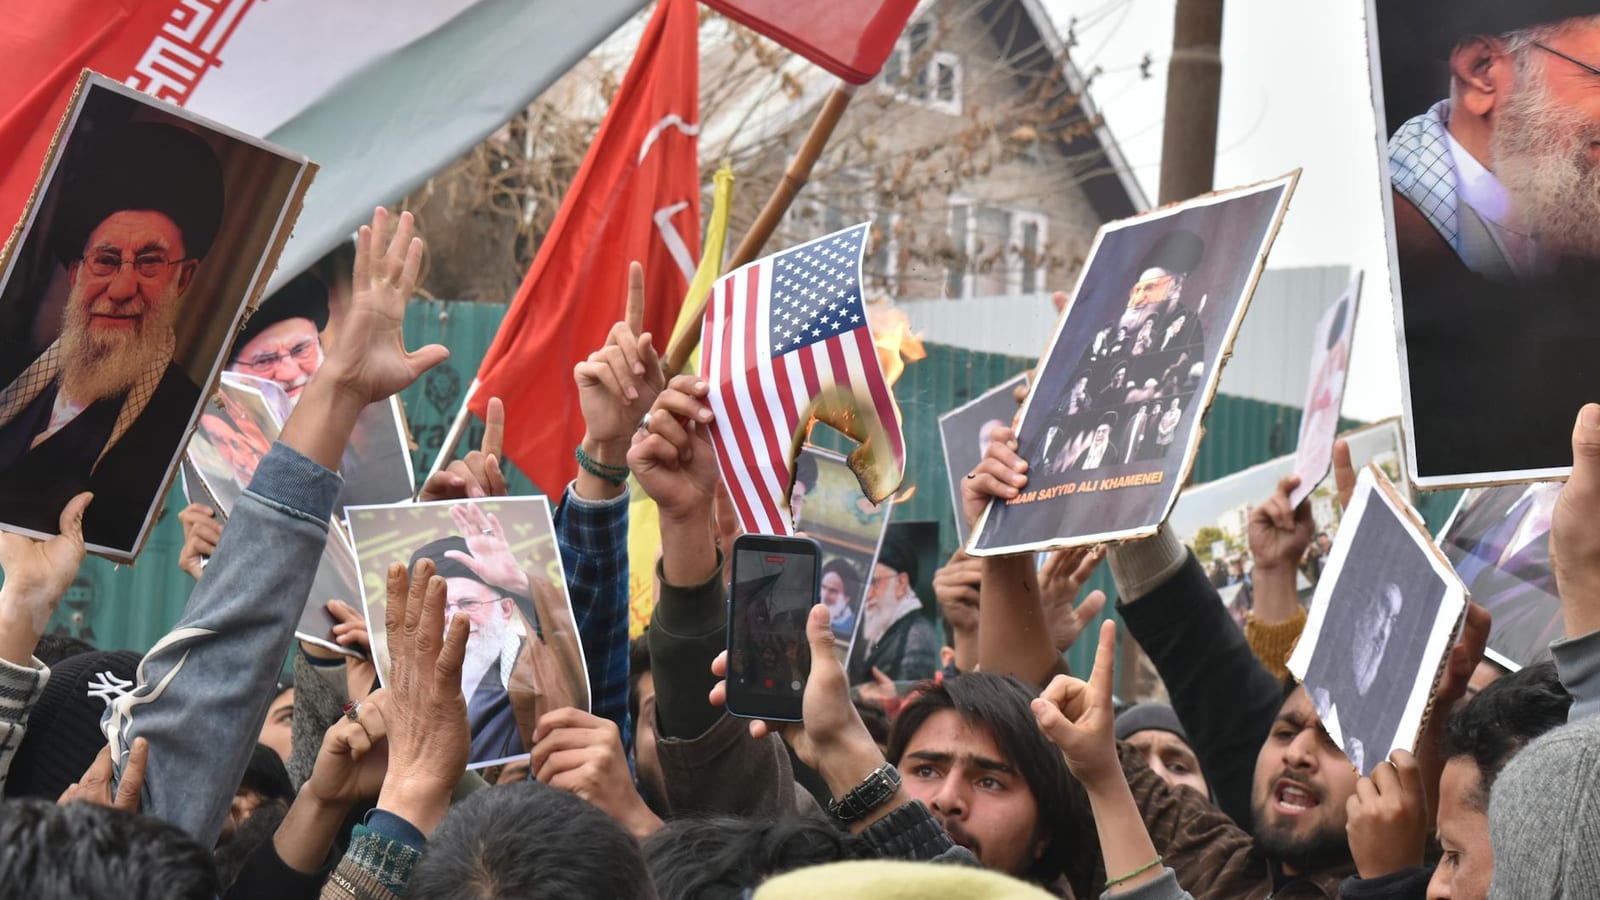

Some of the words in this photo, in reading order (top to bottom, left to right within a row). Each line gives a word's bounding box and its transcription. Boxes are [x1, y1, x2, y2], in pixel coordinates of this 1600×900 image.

[1037, 482, 1076, 501] SAYYID
[1077, 479, 1098, 493] ALI
[1099, 471, 1164, 491] KHAMENEI
